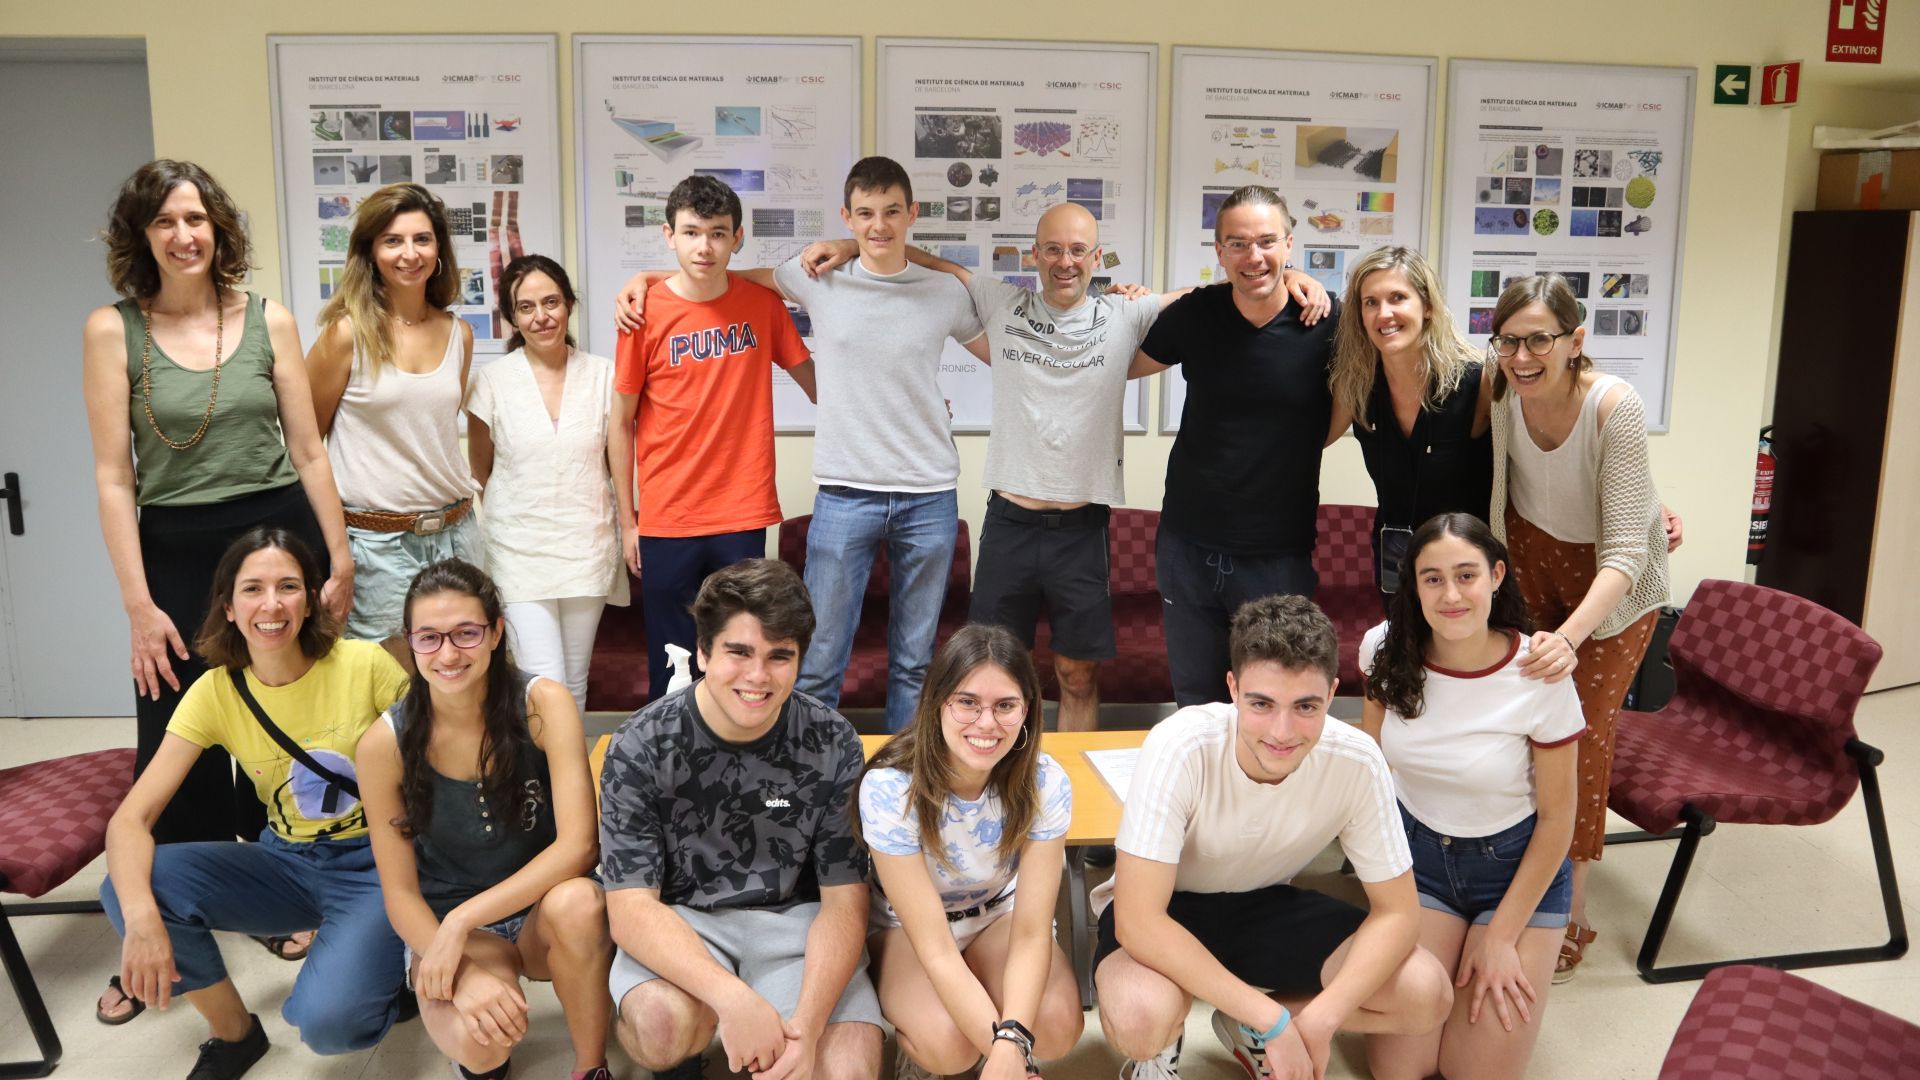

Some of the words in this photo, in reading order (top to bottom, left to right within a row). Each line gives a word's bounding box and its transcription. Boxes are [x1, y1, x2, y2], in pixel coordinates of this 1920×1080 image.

[1832, 45, 1878, 55] EXTINTOR
[670, 322, 757, 366] PUMA
[1002, 348, 1041, 365] NEVER
[1043, 355, 1105, 369] REGULAR
